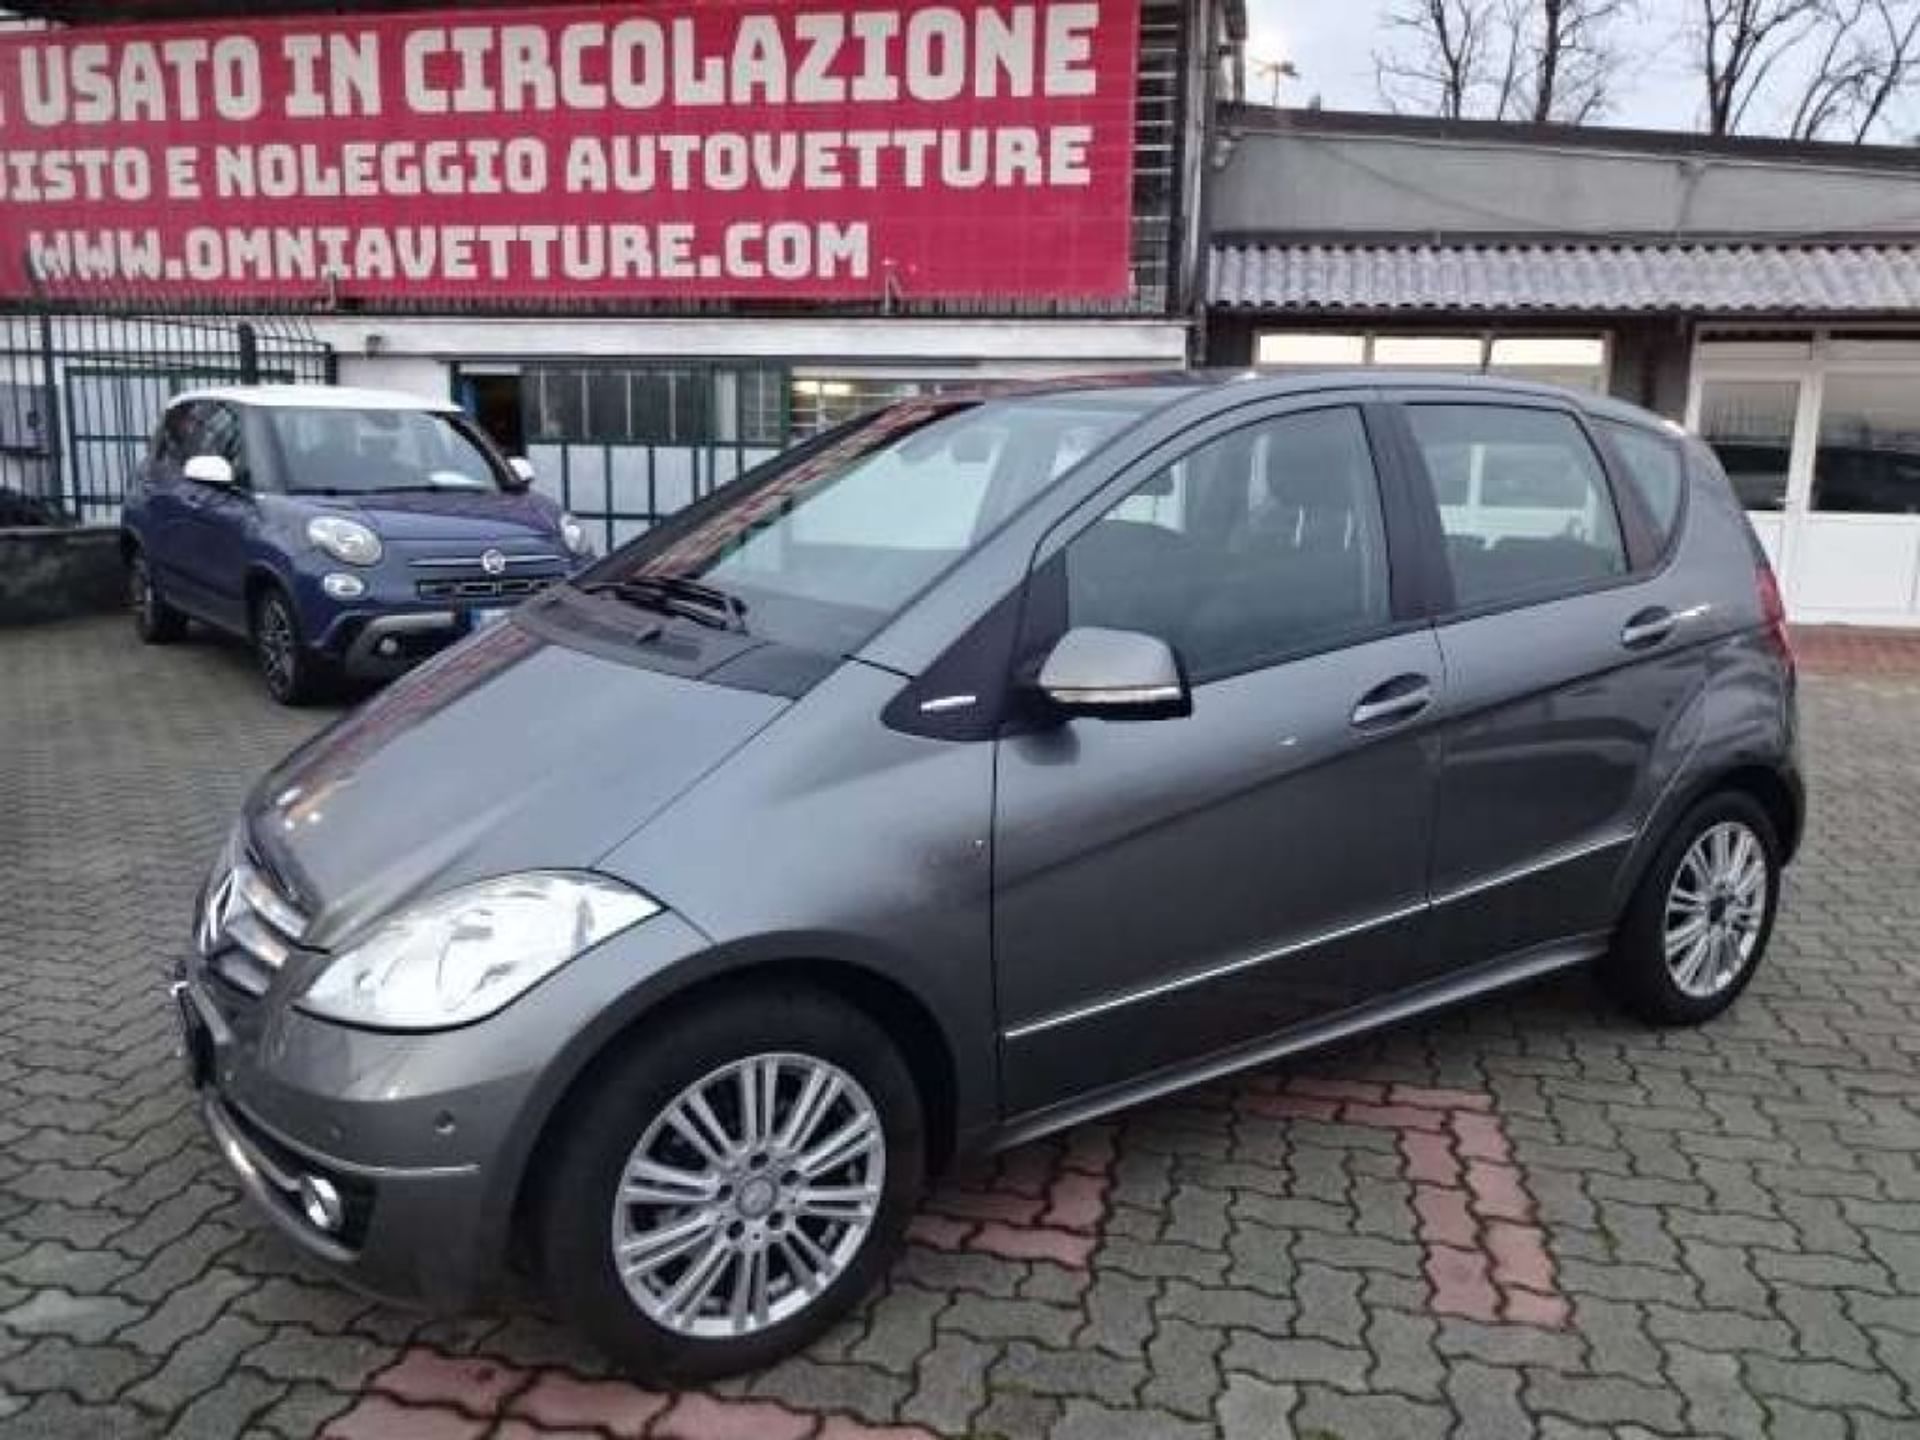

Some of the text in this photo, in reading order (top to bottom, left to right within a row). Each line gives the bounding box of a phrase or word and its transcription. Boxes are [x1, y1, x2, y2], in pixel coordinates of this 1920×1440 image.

[19, 3, 1100, 127] USATO IN CIRCOLAZIONE
[0, 125, 1093, 201] ISTO E NOLEGGIO AUTOVETTURE
[28, 221, 869, 283] WWW.OMNIAVETTURE.COM
